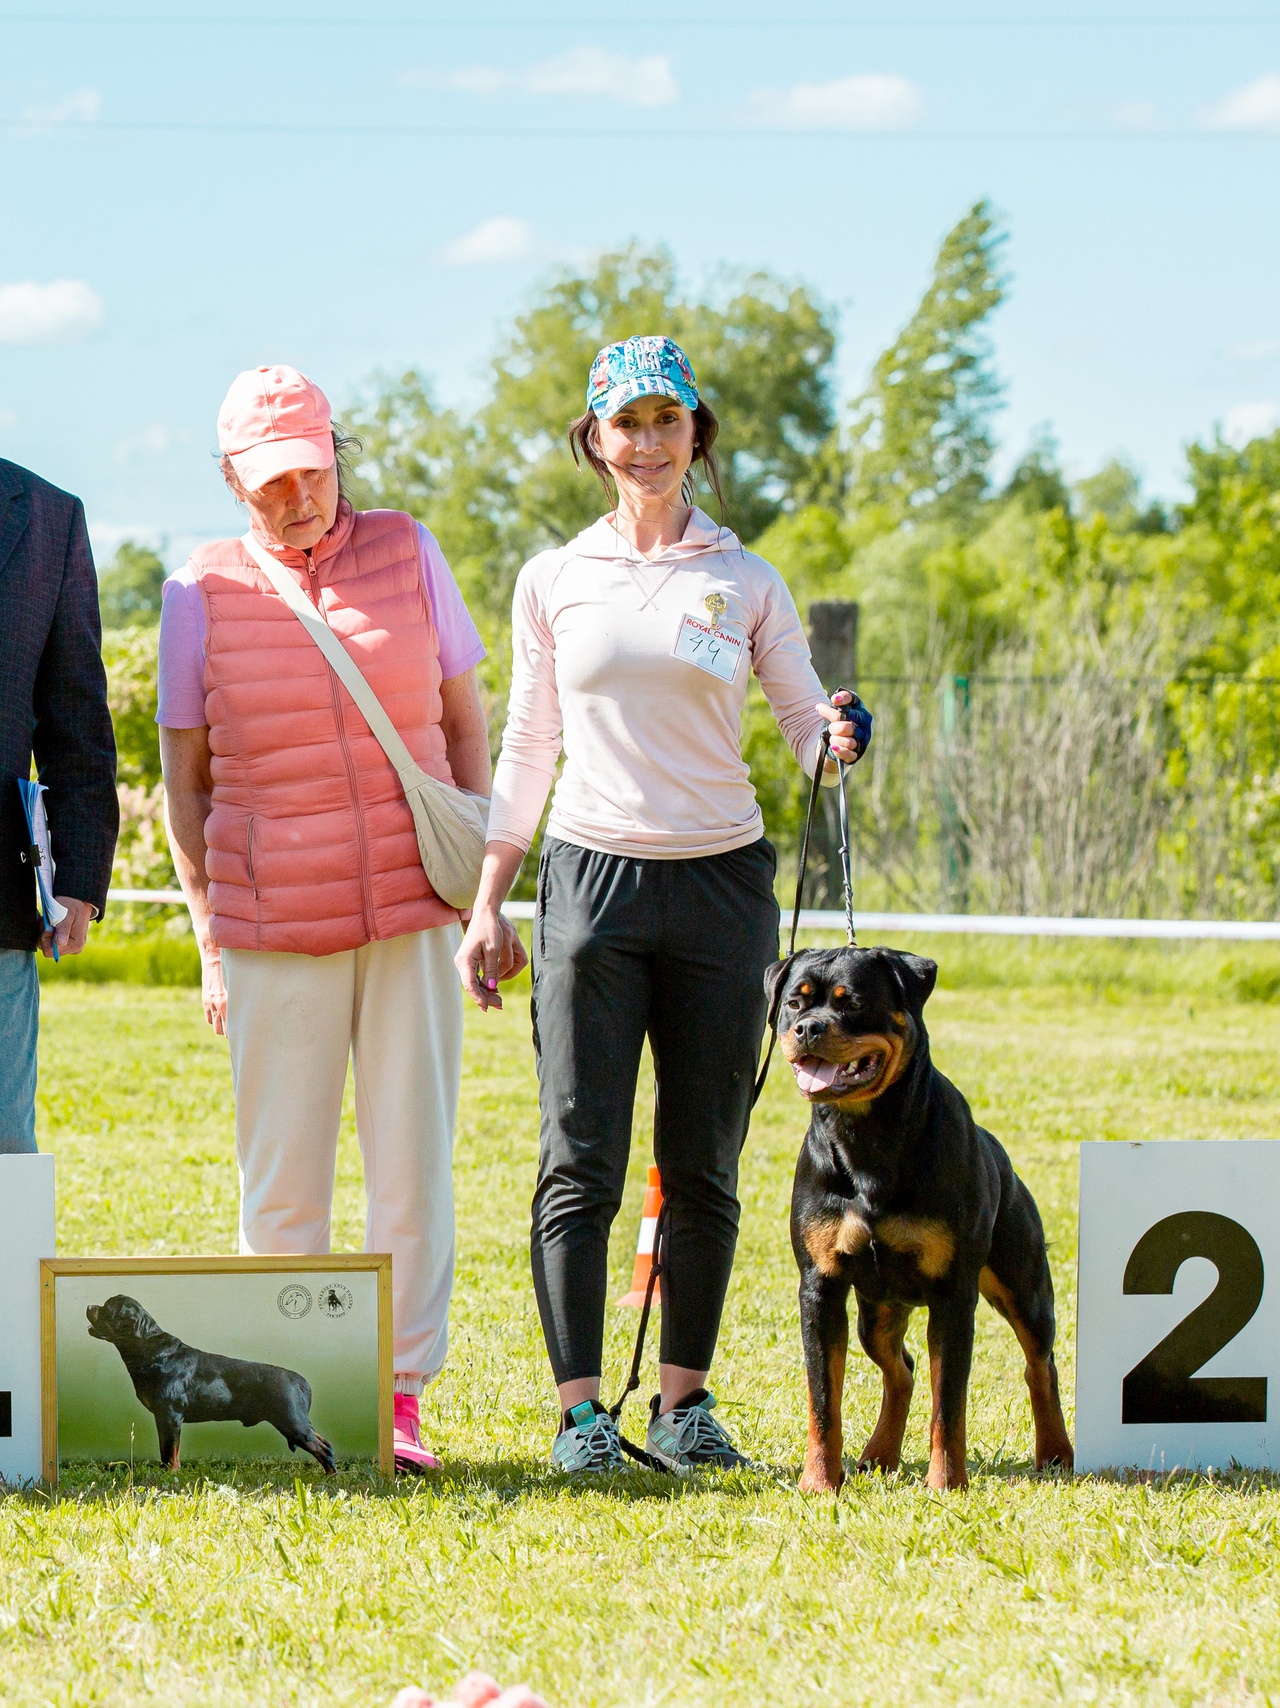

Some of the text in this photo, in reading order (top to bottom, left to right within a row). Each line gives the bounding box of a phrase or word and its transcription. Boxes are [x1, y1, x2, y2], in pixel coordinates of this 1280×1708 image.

[686, 618, 741, 647] ROYAL CANIN
[1121, 1210, 1268, 1425] 2
